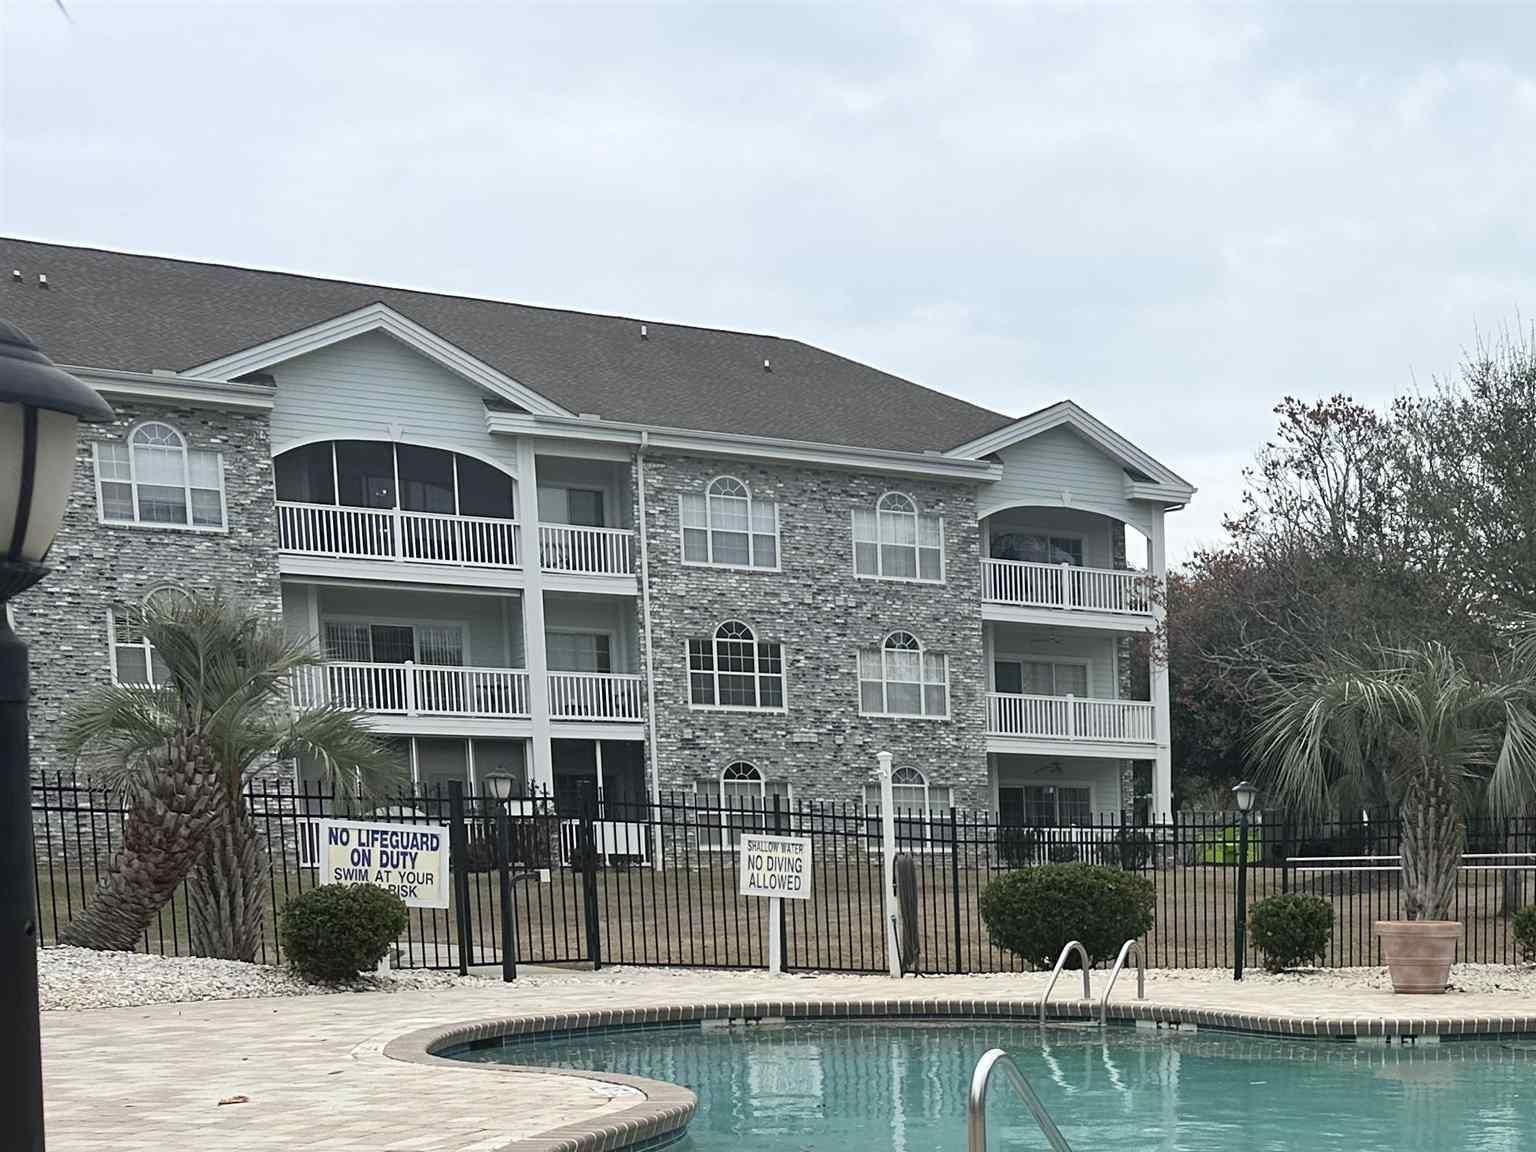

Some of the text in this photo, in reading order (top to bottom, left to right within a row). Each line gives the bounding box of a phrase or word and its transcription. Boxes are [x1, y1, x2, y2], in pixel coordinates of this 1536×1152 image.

[328, 827, 440, 852] NO LIFEGUARD
[747, 839, 803, 855] SHALLOW WATER
[350, 848, 418, 870] ON DUTY
[747, 855, 803, 873] NO DIVING
[334, 867, 434, 885] SWIM AT YOUR
[749, 872, 801, 891] ALLOWED
[388, 884, 417, 898] RISK
